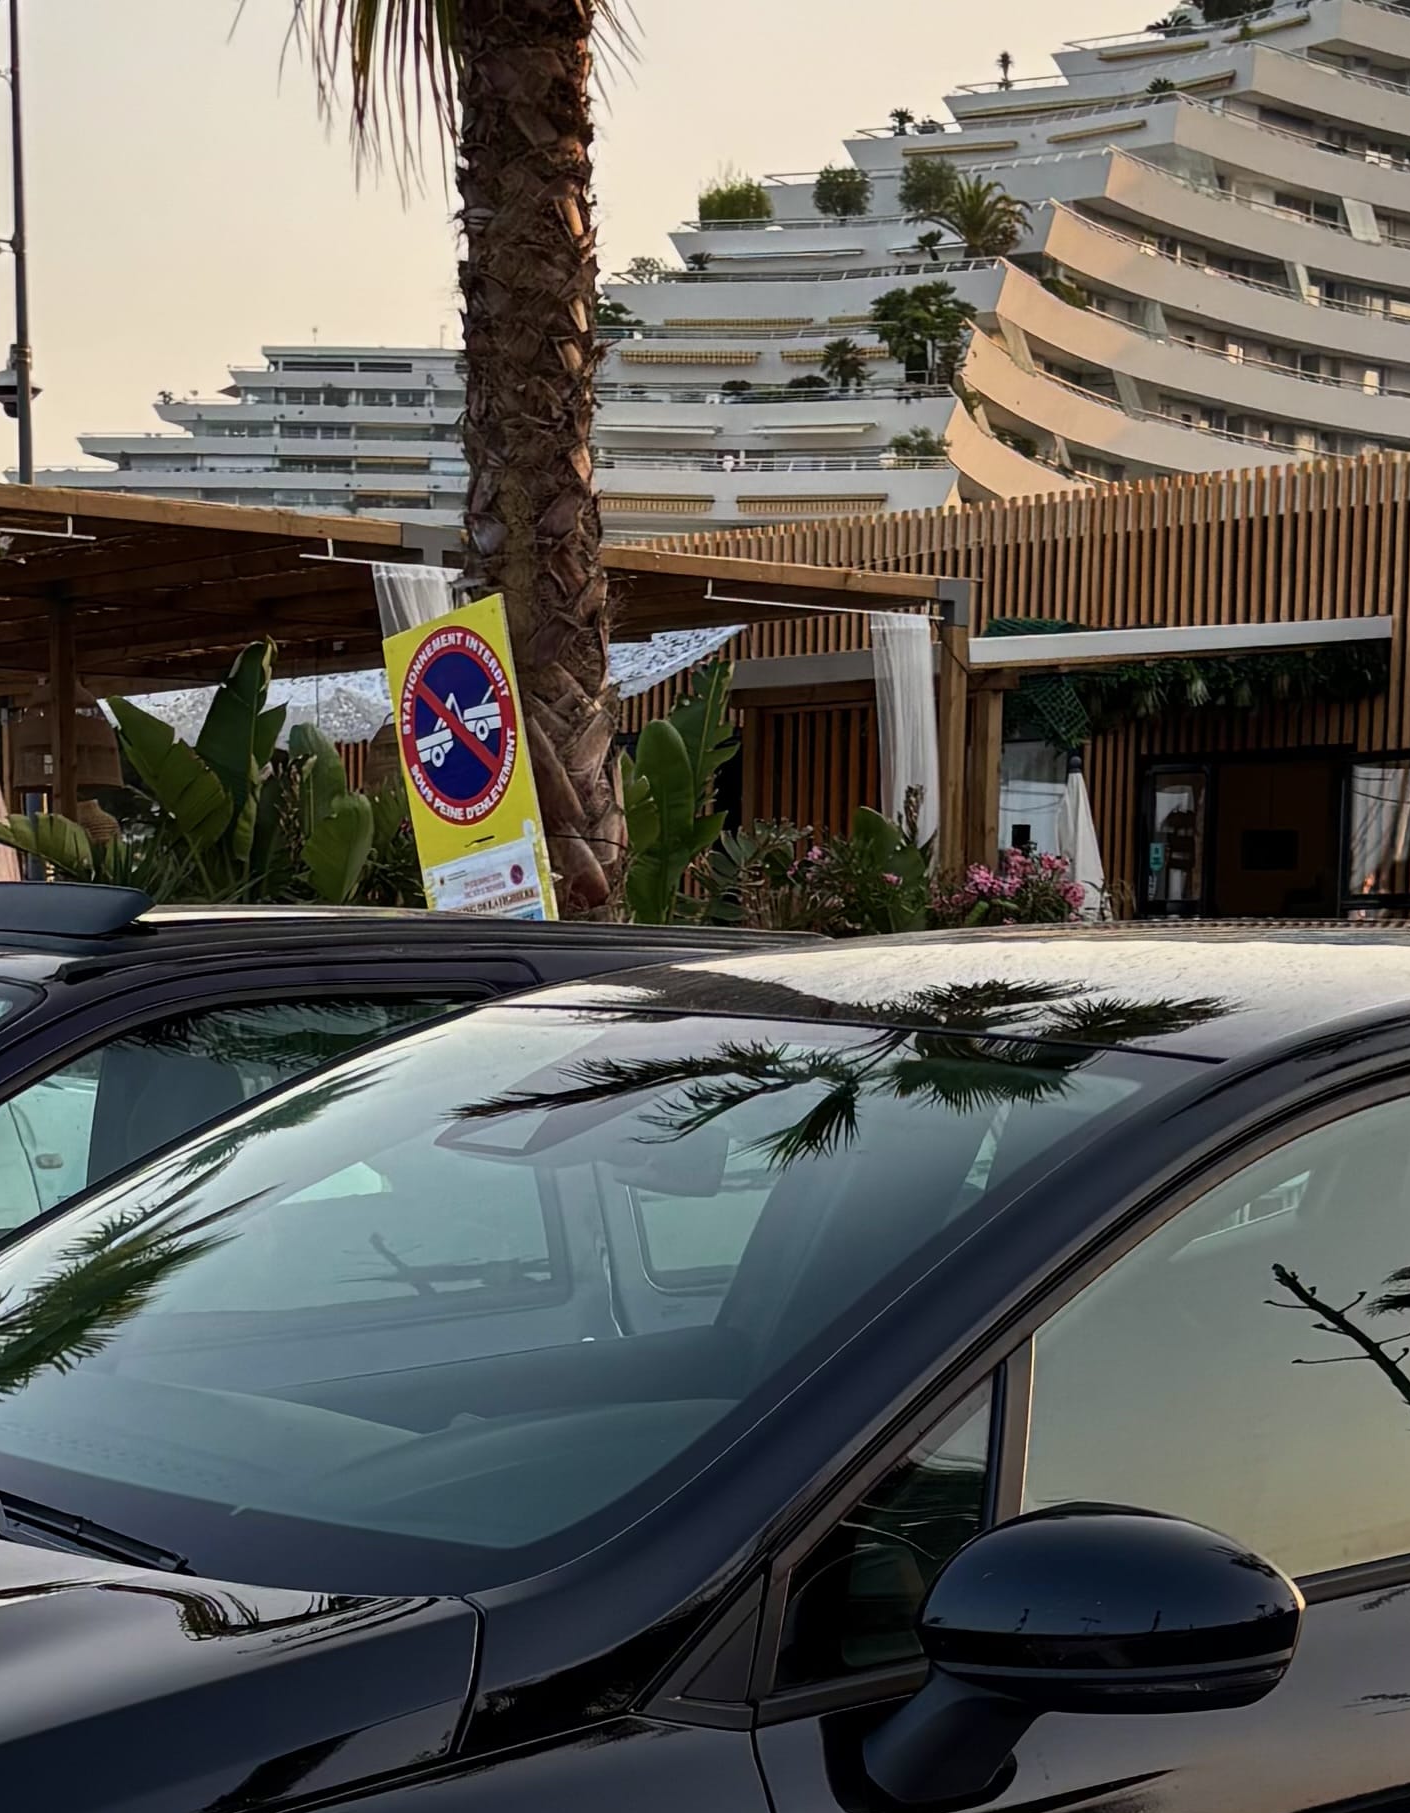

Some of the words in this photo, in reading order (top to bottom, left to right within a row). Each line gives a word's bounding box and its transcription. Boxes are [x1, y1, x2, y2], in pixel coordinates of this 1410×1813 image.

[402, 632, 464, 736] STATIONNEMENT
[465, 634, 510, 697] INTERDIT
[410, 763, 435, 803] SOUS
[433, 797, 466, 820] PEINE
